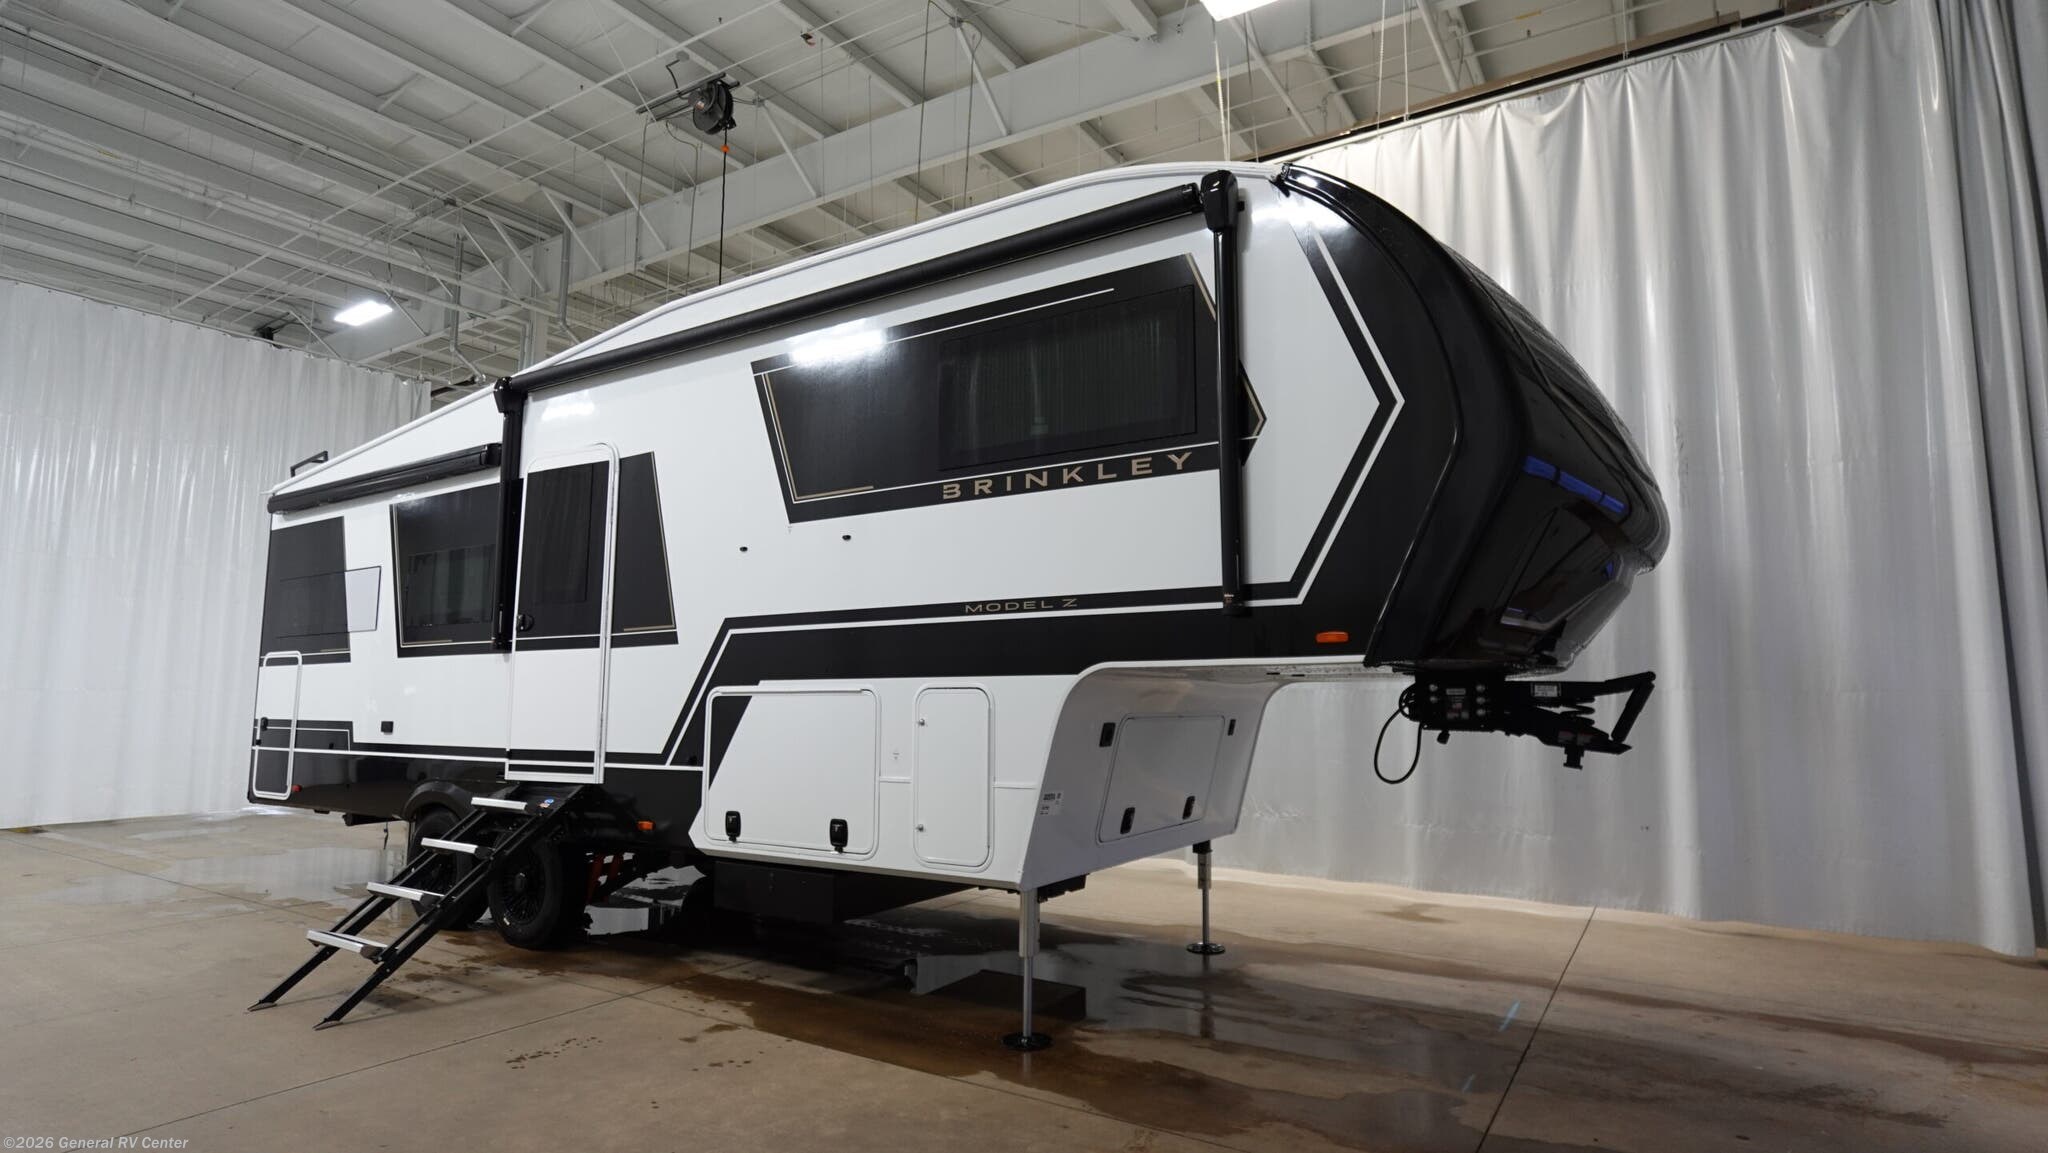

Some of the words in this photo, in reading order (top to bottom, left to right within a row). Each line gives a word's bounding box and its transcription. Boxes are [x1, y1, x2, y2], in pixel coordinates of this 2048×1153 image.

[943, 451, 1192, 500] BRINKLEY
[965, 600, 1054, 614] MODEL
[1062, 598, 1078, 608] Z
